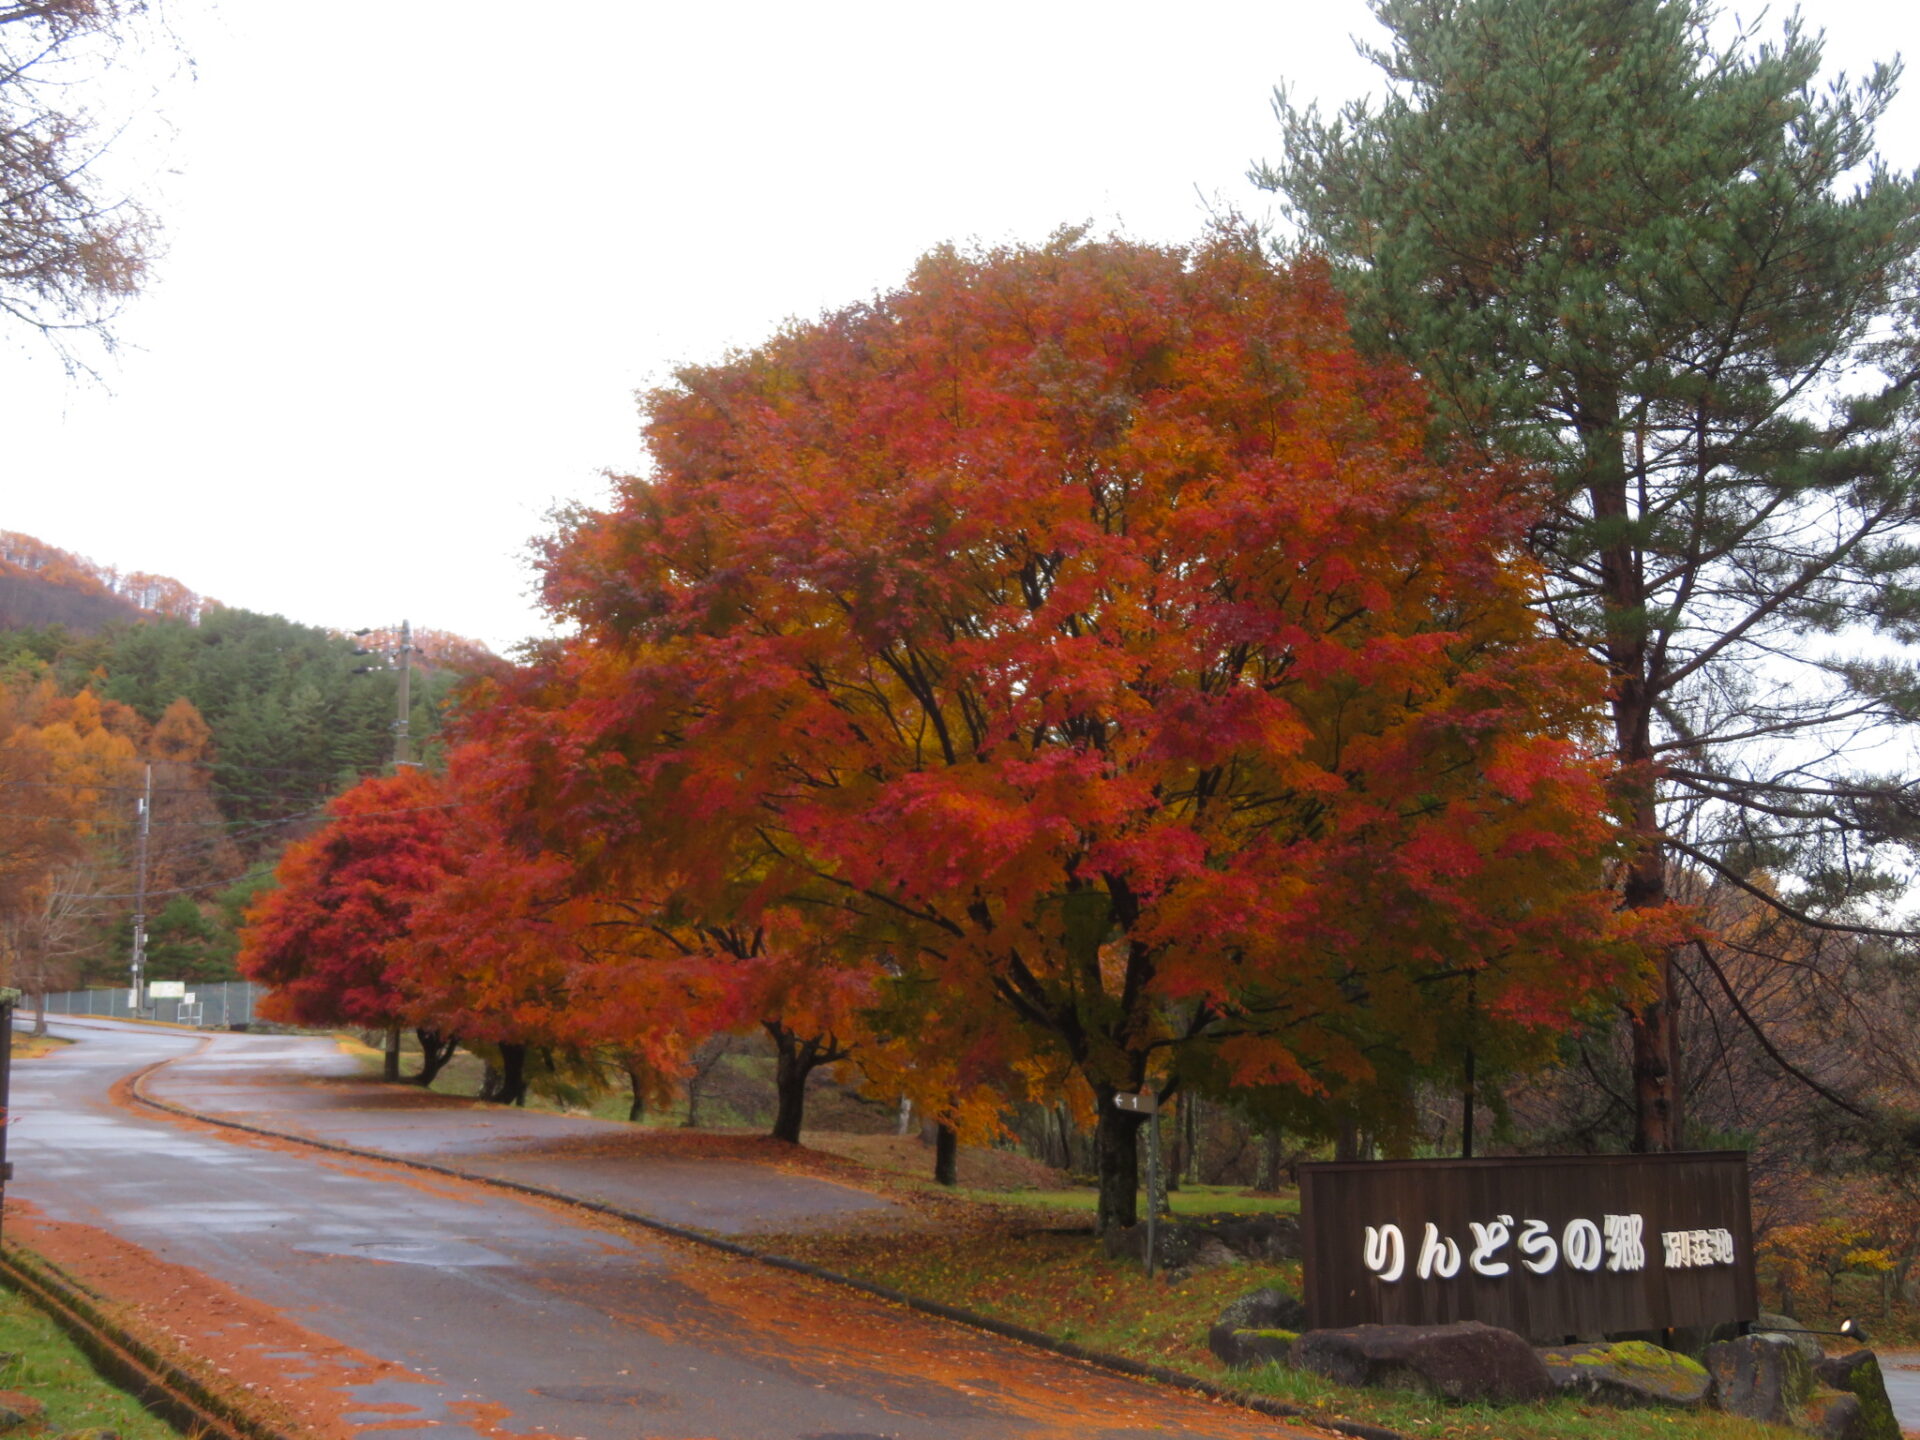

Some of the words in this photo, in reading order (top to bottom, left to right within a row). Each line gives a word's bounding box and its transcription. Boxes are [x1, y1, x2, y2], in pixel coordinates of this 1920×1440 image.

[1131, 1096, 1138, 1109] 1
[1364, 1213, 1645, 1282] りんどうの郷
[1661, 1228, 1734, 1268] 別荘地
